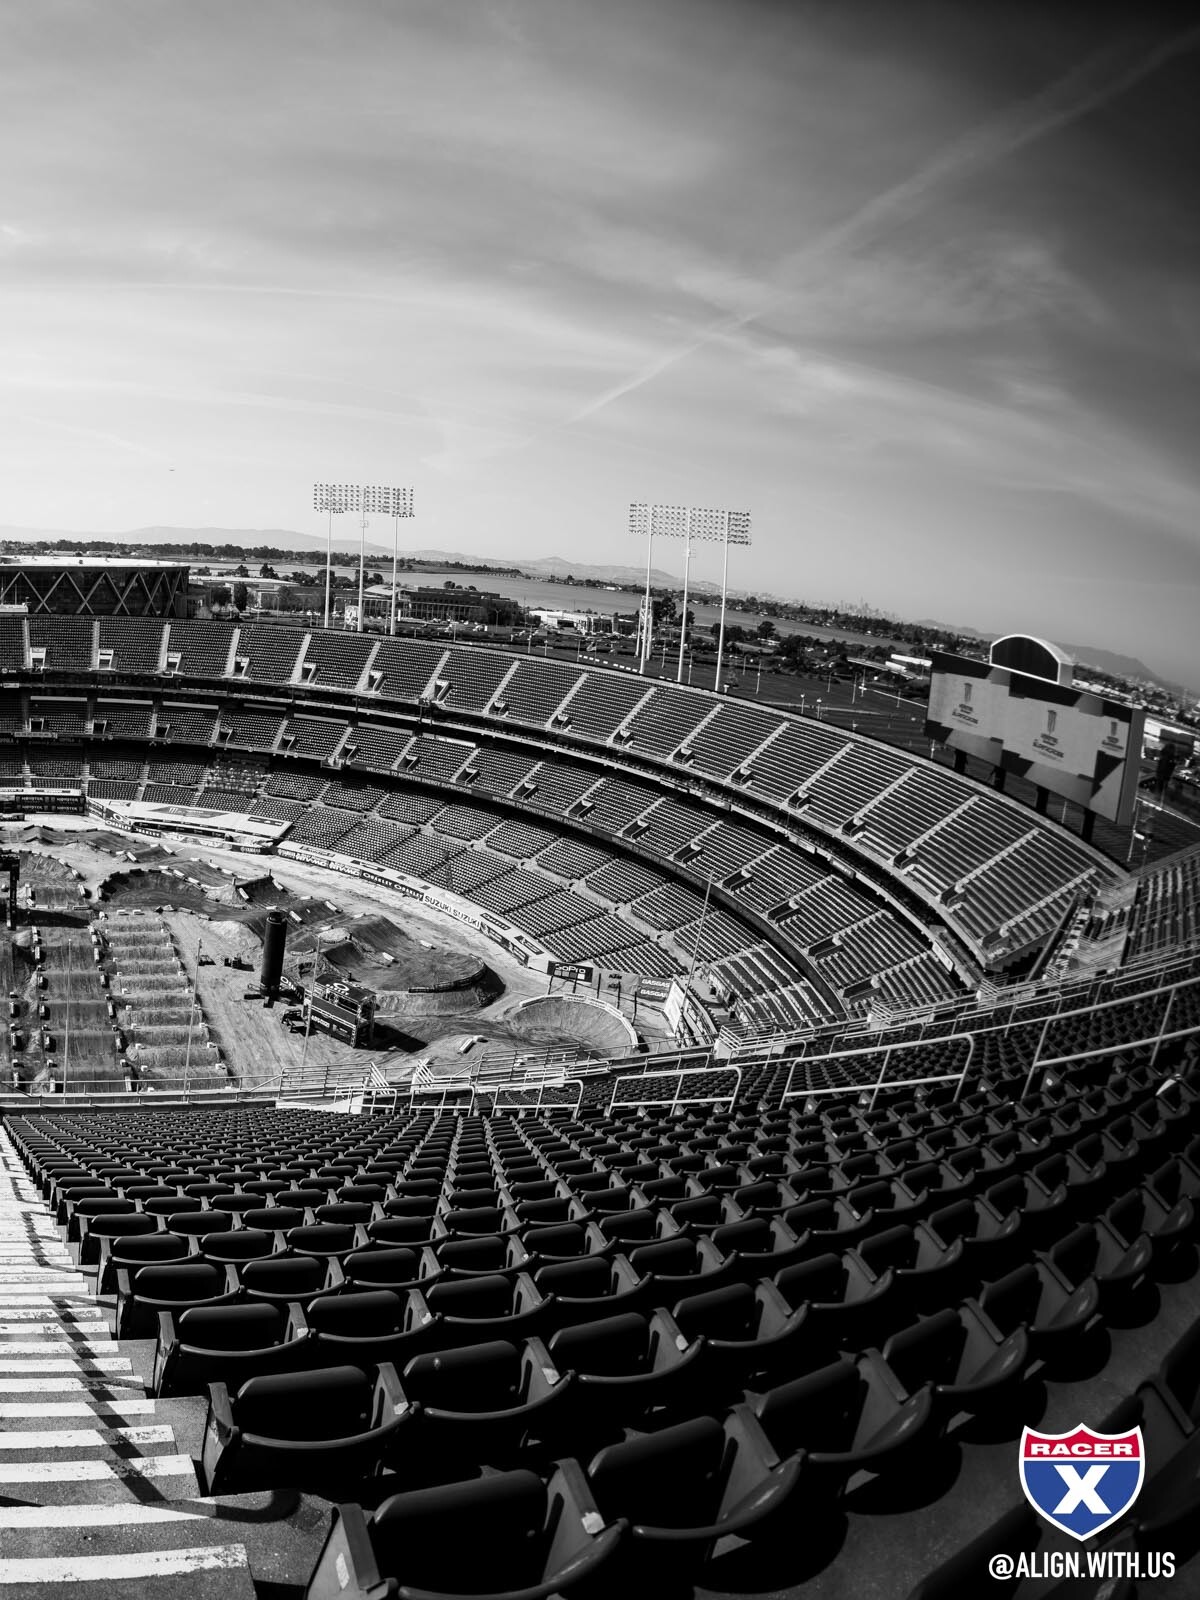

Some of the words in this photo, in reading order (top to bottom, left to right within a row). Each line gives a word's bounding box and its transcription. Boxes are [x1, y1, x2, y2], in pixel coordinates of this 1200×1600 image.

[366, 766, 390, 776] WELCOME
[398, 772, 421, 782] MONSTER
[421, 777, 441, 787] ENERGY
[441, 782, 472, 794] SUPERCROSS
[516, 801, 523, 809] TO
[362, 872, 393, 886] OAKLEY
[394, 883, 423, 899] OAKLEY
[424, 895, 452, 913] SUZUKI
[452, 909, 480, 928] SUZUKI
[555, 963, 586, 973] GoPro
[641, 979, 670, 988] GASGAS
